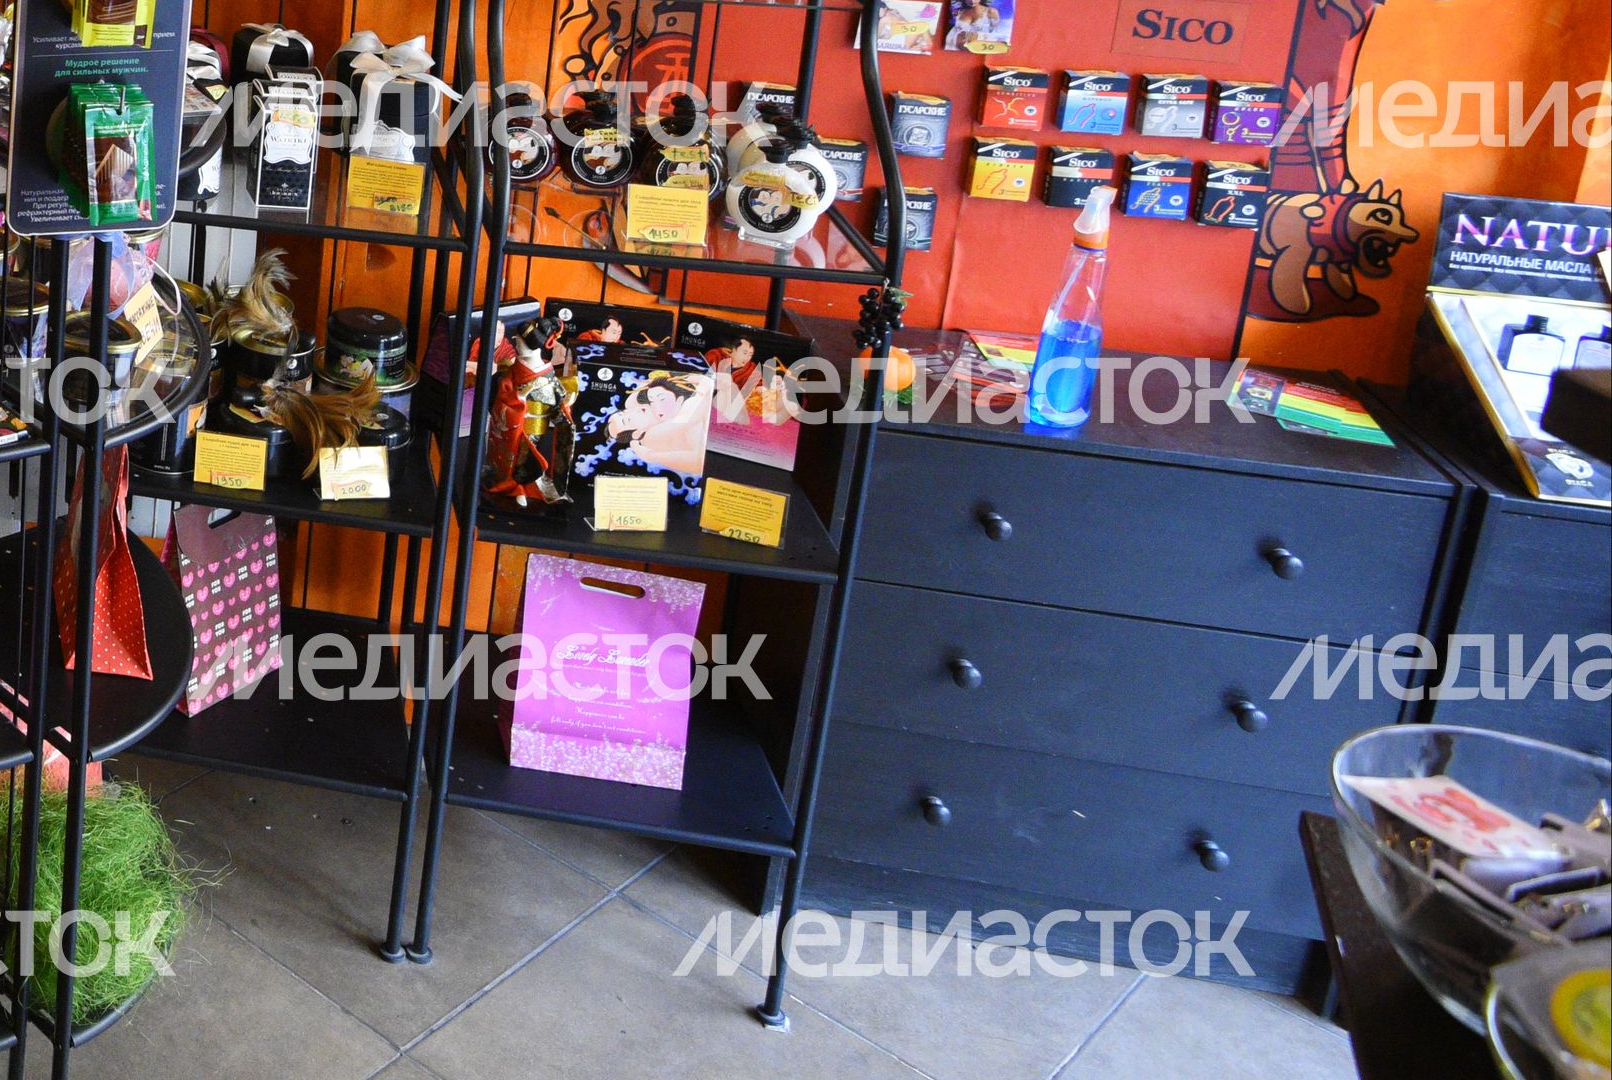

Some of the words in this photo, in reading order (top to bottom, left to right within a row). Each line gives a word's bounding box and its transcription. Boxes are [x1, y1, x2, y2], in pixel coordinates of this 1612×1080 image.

[65, 58, 100, 68] Мудрое
[100, 57, 140, 66] решение
[54, 70, 71, 78] для
[72, 68, 111, 76] сильных
[111, 66, 149, 75] мужчин.
[898, 103, 948, 117] ГУСАРСКИЕ
[1450, 251, 1543, 270] НАТУРАЛЬНЫЕ
[1544, 259, 1592, 275] МАСЛА
[590, 382, 617, 391] SHUNGA
